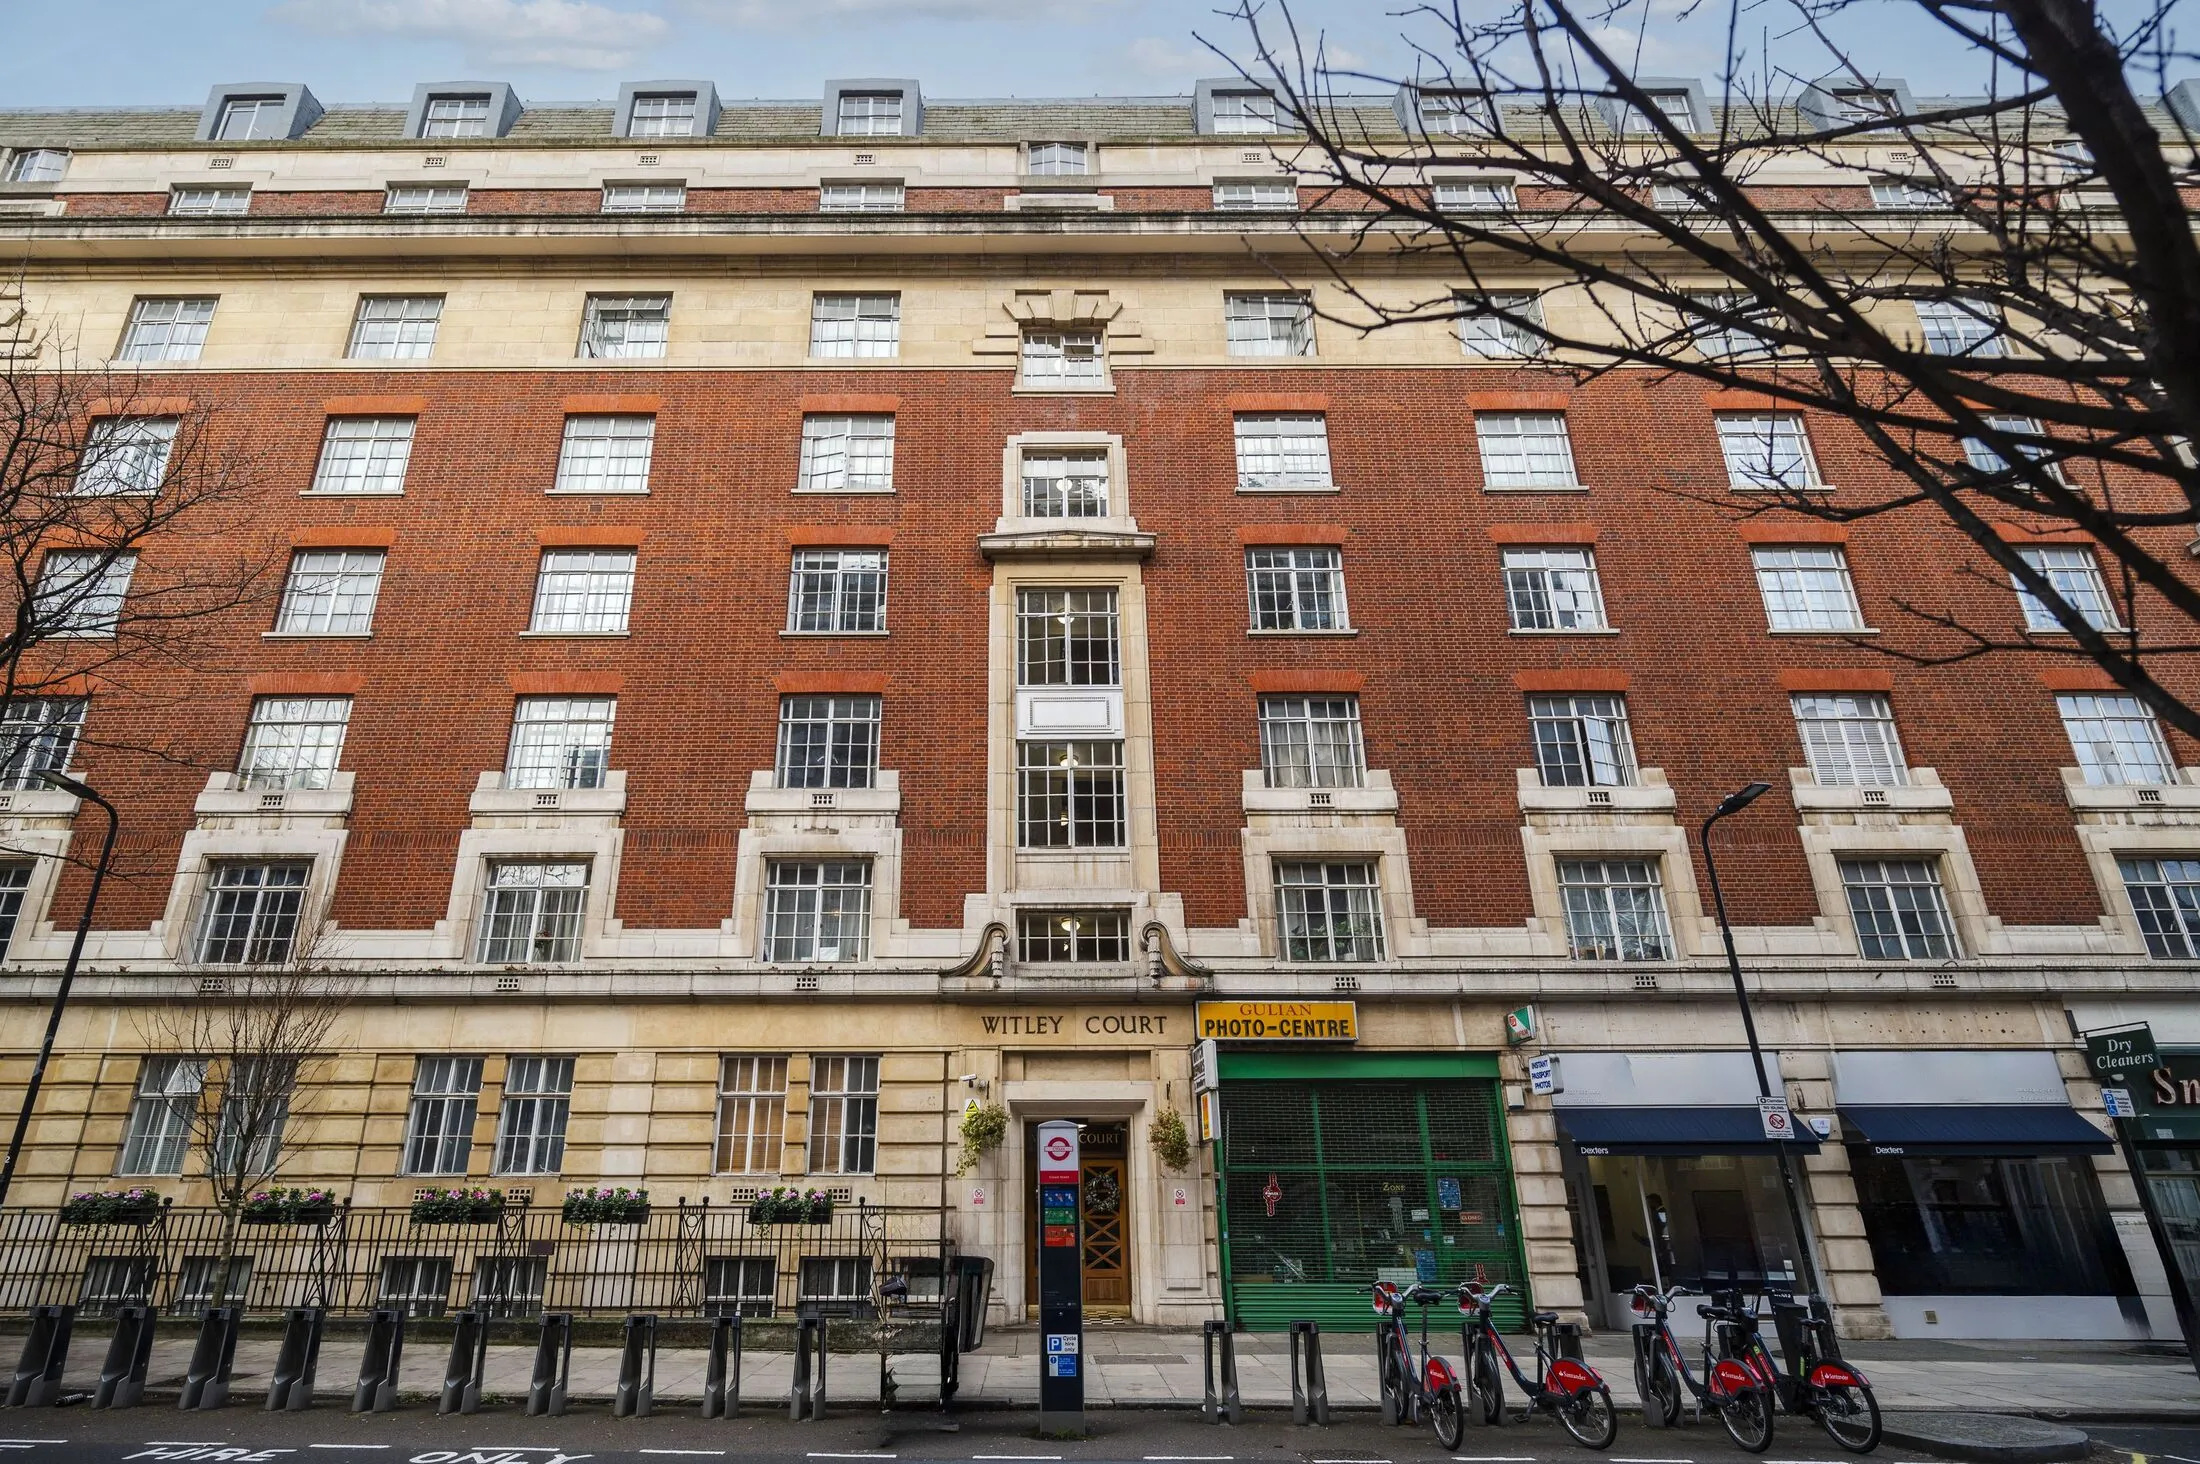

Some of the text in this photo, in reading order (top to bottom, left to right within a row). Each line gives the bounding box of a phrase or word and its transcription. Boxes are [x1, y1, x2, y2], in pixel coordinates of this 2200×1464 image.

[1239, 1003, 1312, 1016] GULIAN
[981, 1015, 1167, 1034] WITLEY COURT
[1204, 1019, 1350, 1037] PHOTO-CENTRE
[2107, 1038, 2132, 1053] Dry
[1531, 1060, 1548, 1069] INSTANT
[2096, 1053, 2154, 1069] Cleaners
[1531, 1070, 1551, 1079] PASSPORT
[1534, 1081, 1551, 1089] PHOTOS
[1079, 1133, 1120, 1144] COURT
[1580, 1146, 1609, 1154] Dexters
[1875, 1146, 1904, 1154] Dexters
[1563, 1371, 1586, 1381] Santander
[1725, 1371, 1745, 1381] Santander
[1829, 1373, 1849, 1381] Santander
[121, 1447, 595, 1464] HIRE ONLY
